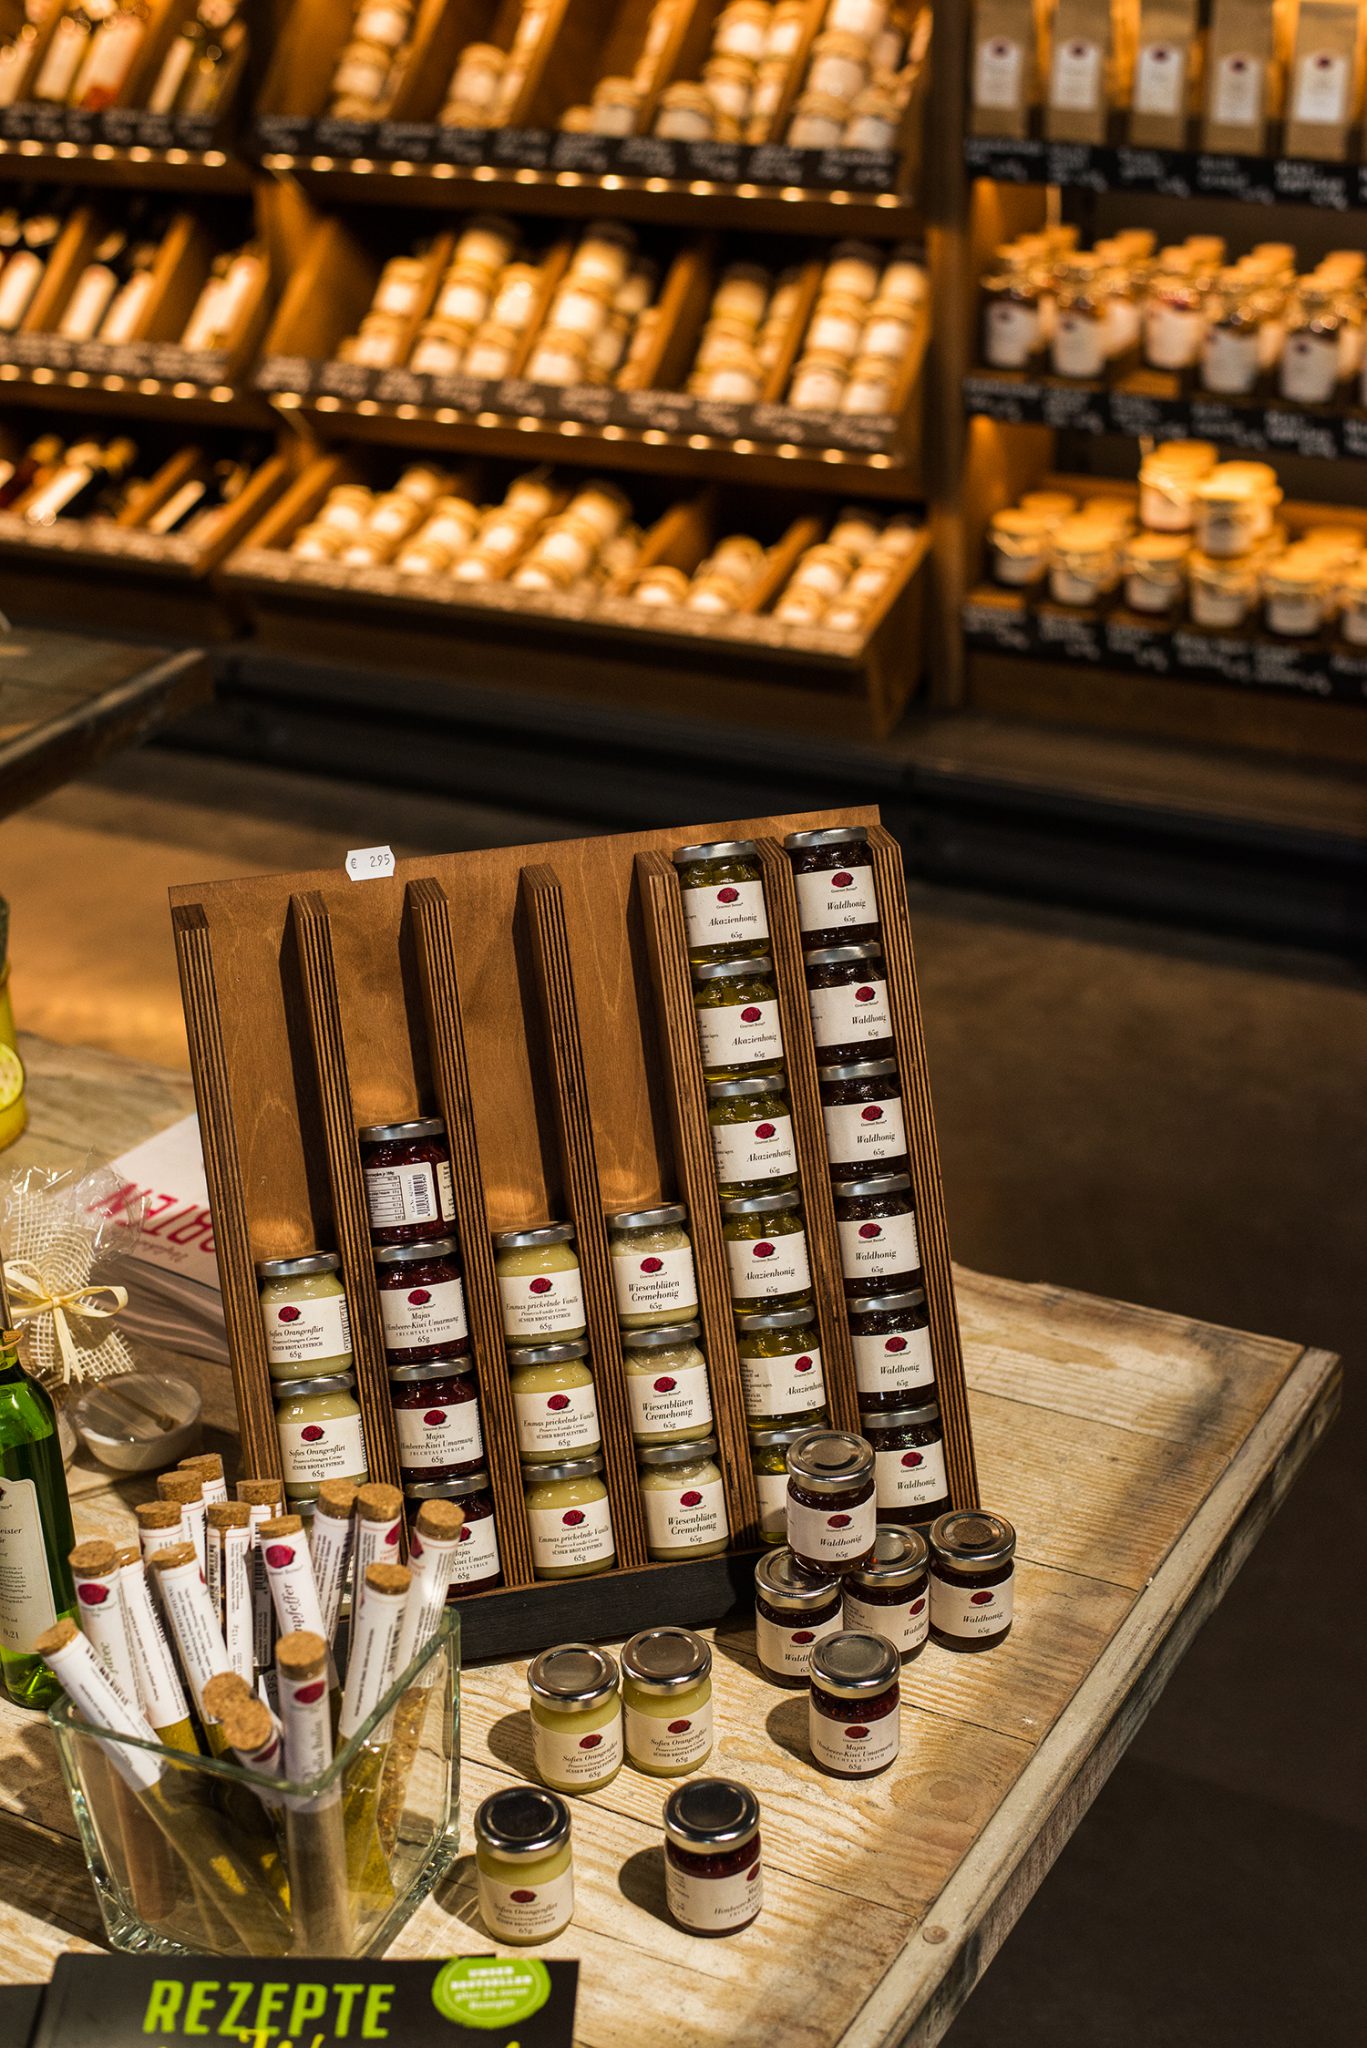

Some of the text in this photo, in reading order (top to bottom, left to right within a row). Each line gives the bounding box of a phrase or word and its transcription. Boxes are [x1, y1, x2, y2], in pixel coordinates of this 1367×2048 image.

[350, 854, 390, 870] € 295
[826, 898, 866, 912] Waldhonig
[708, 913, 758, 927] Akazienhonig
[844, 915, 856, 924] 65g
[730, 932, 743, 940] 65g
[852, 1012, 887, 1025] Waldhonig
[868, 1029, 880, 1038] 65g
[732, 1032, 777, 1046] Akazienhonig
[754, 1050, 766, 1058] 65g
[856, 1132, 896, 1144] Waldhonig
[746, 1147, 792, 1163] Akazienhonig
[873, 1148, 886, 1156] 65g
[769, 1166, 781, 1174] 65g
[856, 1249, 897, 1262] Waldhonig
[744, 1266, 796, 1281] Akazienhonig
[871, 1266, 884, 1274] 65g
[628, 1279, 680, 1292] Wiesenblüten
[766, 1286, 778, 1294] 65g
[631, 1289, 680, 1302] Cremehonig
[650, 1302, 663, 1310] 65g
[411, 1312, 430, 1322] Majas
[417, 1336, 430, 1344] 65g
[290, 1351, 302, 1359] 65g
[880, 1362, 920, 1376] Waldhonig
[896, 1379, 910, 1388] 65g
[642, 1398, 694, 1411] Wiesenblüten
[645, 1408, 693, 1422] Cremehonig
[663, 1420, 676, 1429] 65g
[426, 1433, 445, 1442] Majas
[432, 1456, 444, 1464] 65g
[312, 1470, 325, 1478] 65g
[896, 1476, 936, 1490] Waldhonig
[914, 1494, 926, 1502] 65g
[668, 1512, 718, 1526] Wiesenblüten
[670, 1521, 717, 1536] Cremehonig
[689, 1535, 702, 1543] 65g
[820, 1534, 862, 1547] Waldhonig
[574, 1554, 586, 1562] 65g
[458, 1572, 470, 1580] 65g
[978, 1626, 990, 1635] 65g
[800, 1666, 810, 1674] 65
[846, 1744, 867, 1752] Majas
[562, 1754, 582, 1764] Sofies
[676, 1756, 689, 1764] 65g
[142, 1979, 395, 2040] REZEPTE
